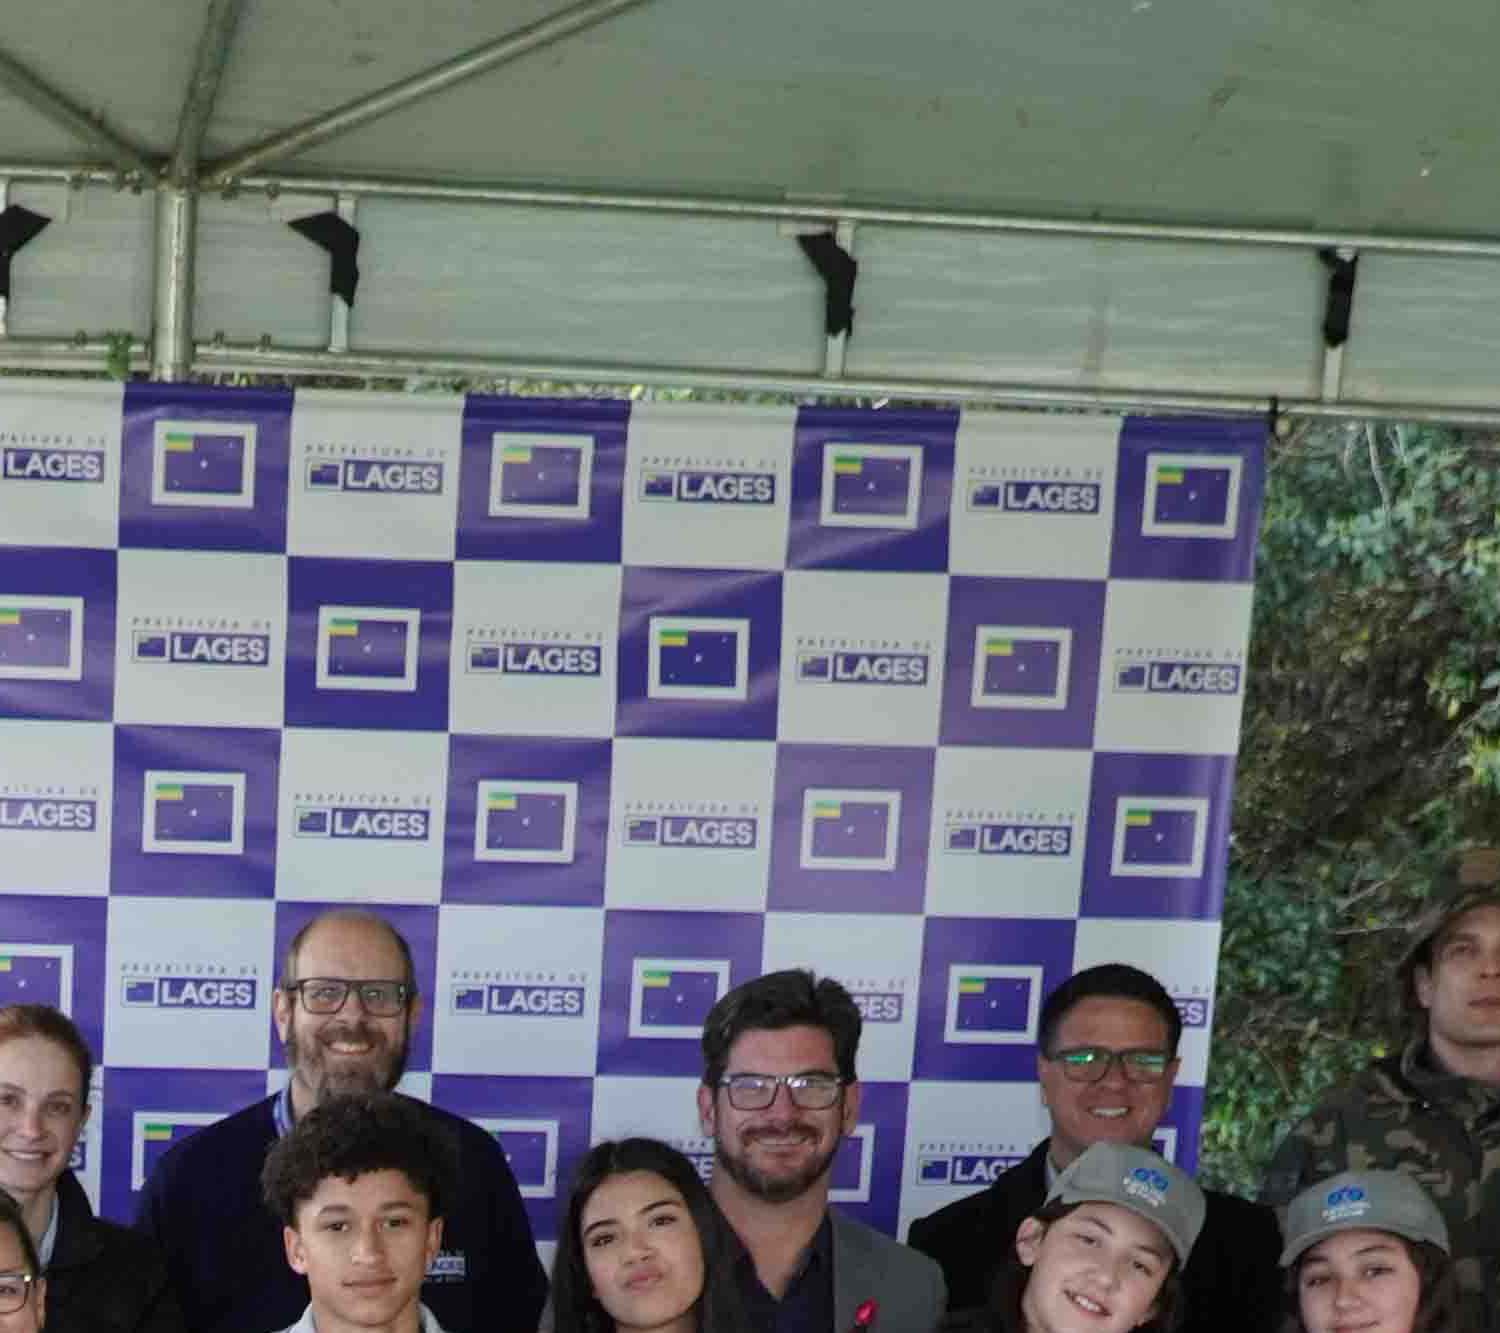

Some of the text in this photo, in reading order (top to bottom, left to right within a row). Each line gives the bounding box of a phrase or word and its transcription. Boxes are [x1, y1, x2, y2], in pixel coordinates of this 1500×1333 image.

[7, 452, 100, 478] LAGES
[346, 465, 439, 490] LAGES
[680, 474, 771, 501] LAGES
[1007, 484, 1095, 510] LAGES
[174, 634, 264, 661] LAGES
[507, 647, 598, 671] LAGES
[837, 656, 923, 682] LAGES
[1151, 665, 1237, 691] LAGES
[0, 802, 92, 827] LAGES
[335, 811, 425, 837] LAGES
[664, 820, 752, 845] LAGES
[983, 828, 1067, 852] LAGES
[162, 980, 254, 1007] LAGES
[492, 989, 580, 1013] LAGES
